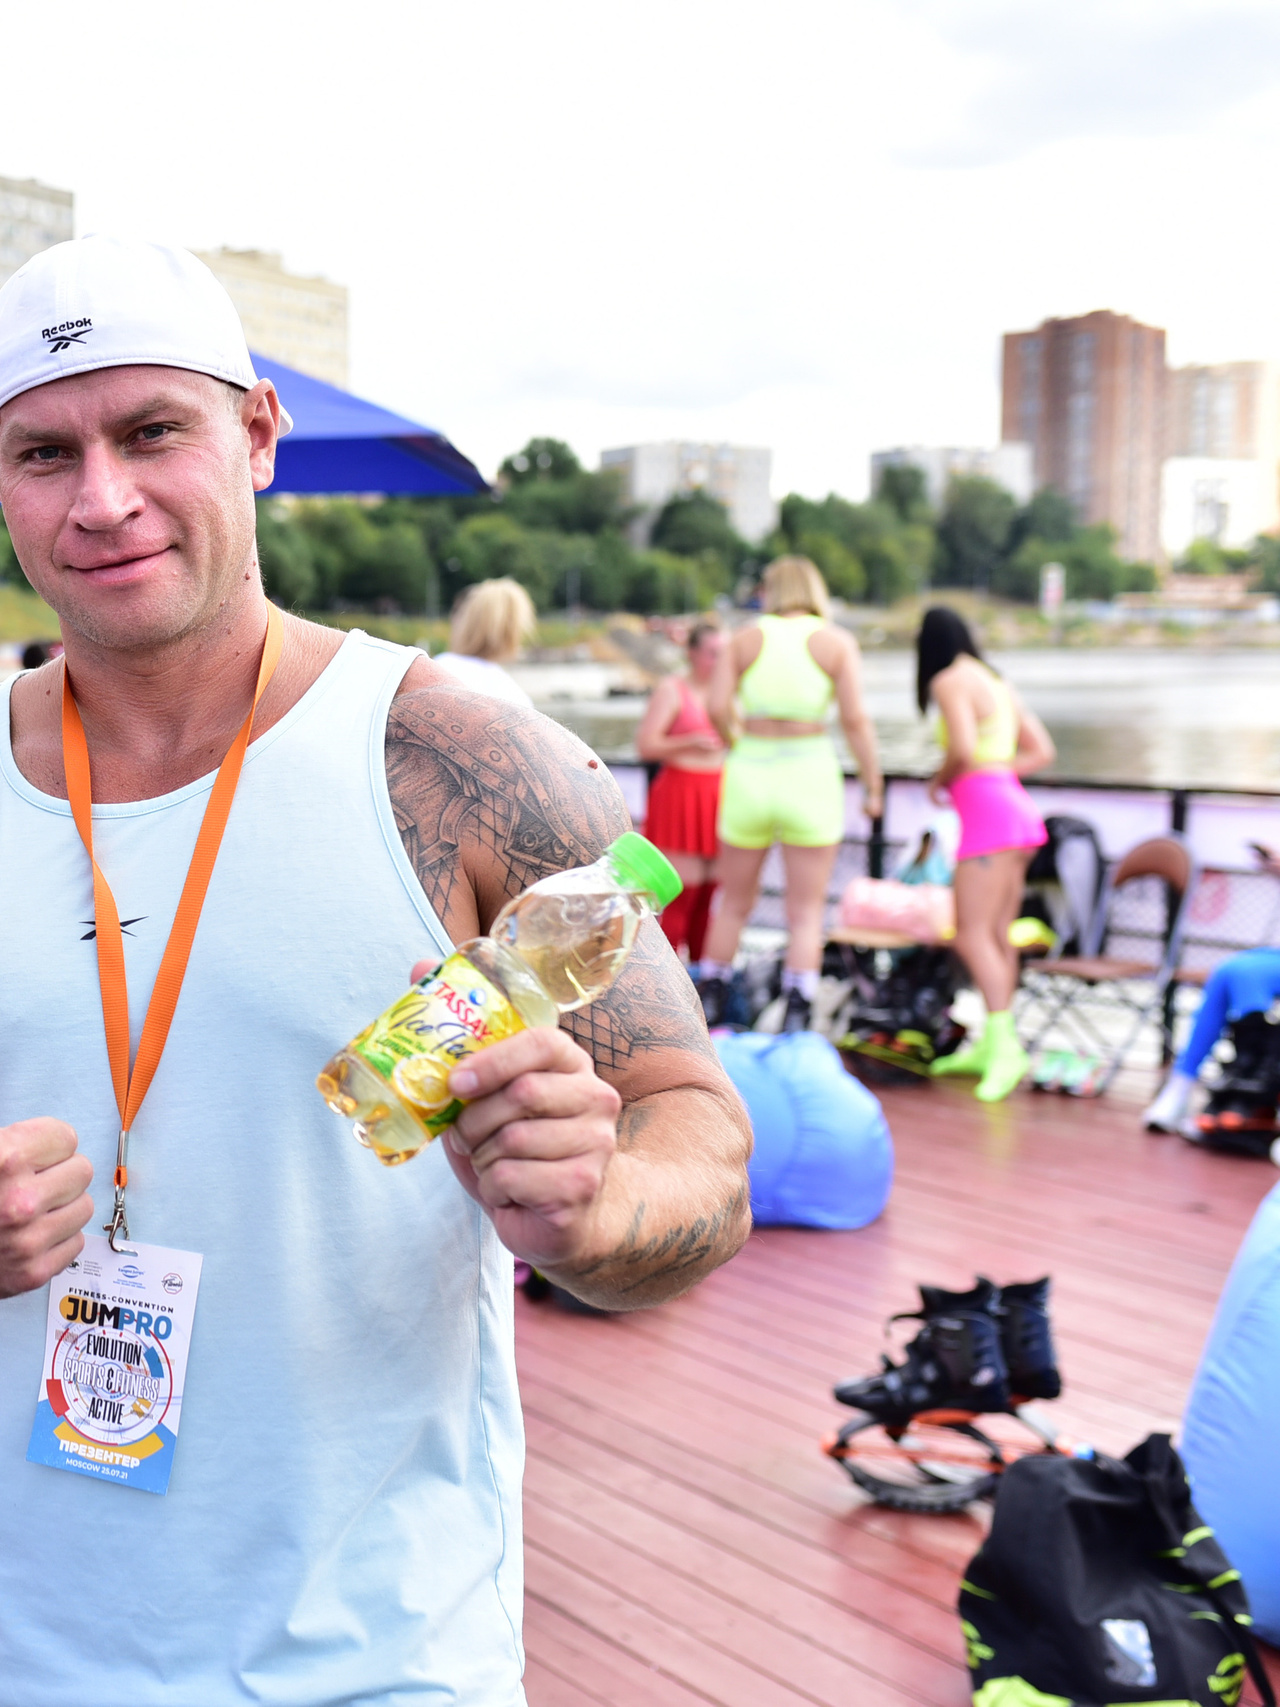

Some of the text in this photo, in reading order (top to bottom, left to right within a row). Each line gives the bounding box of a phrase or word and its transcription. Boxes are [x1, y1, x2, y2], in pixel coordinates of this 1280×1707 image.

[42, 318, 92, 339] Reebok
[390, 1001, 434, 1035] Ice
[434, 981, 492, 1042] TASSAY
[69, 1287, 174, 1313] FITNESS-CONVENTION
[66, 1297, 172, 1340] JUMPRO
[86, 1333, 142, 1366] EVOLUTION
[63, 1358, 159, 1402] SPORTS & FITNESS
[88, 1396, 125, 1425] ACTIVE
[59, 1439, 140, 1469] ПРЕЗЕНТЕР
[66, 1458, 129, 1480] MOSCOW 25.07.21
